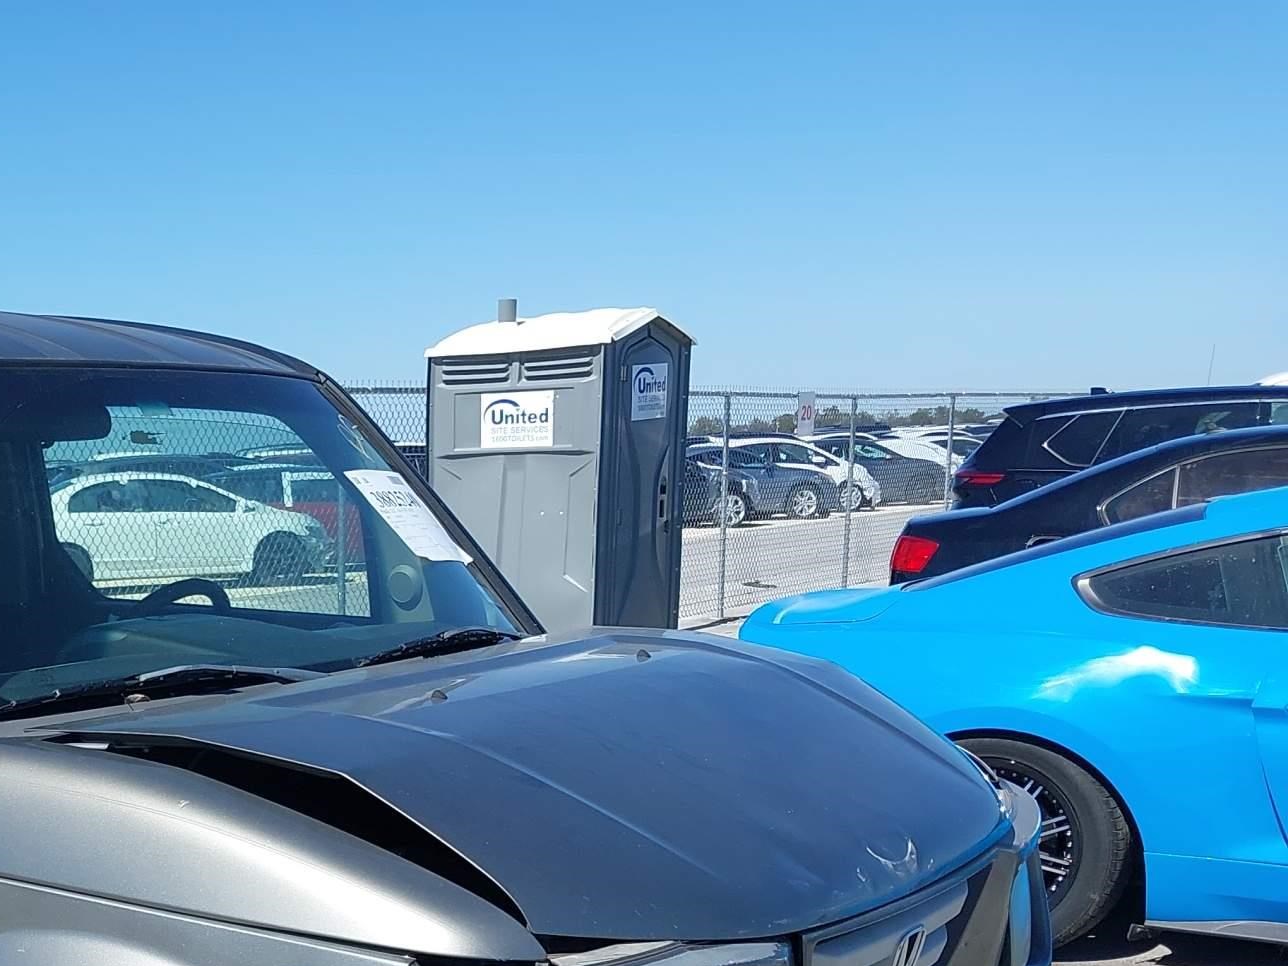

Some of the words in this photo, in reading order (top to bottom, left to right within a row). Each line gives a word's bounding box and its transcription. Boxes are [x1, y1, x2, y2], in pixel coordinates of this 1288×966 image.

[638, 376, 666, 394] United
[491, 407, 549, 425] United
[800, 404, 812, 421] 20
[491, 426, 509, 434] SITE
[510, 425, 549, 434] SERVICES
